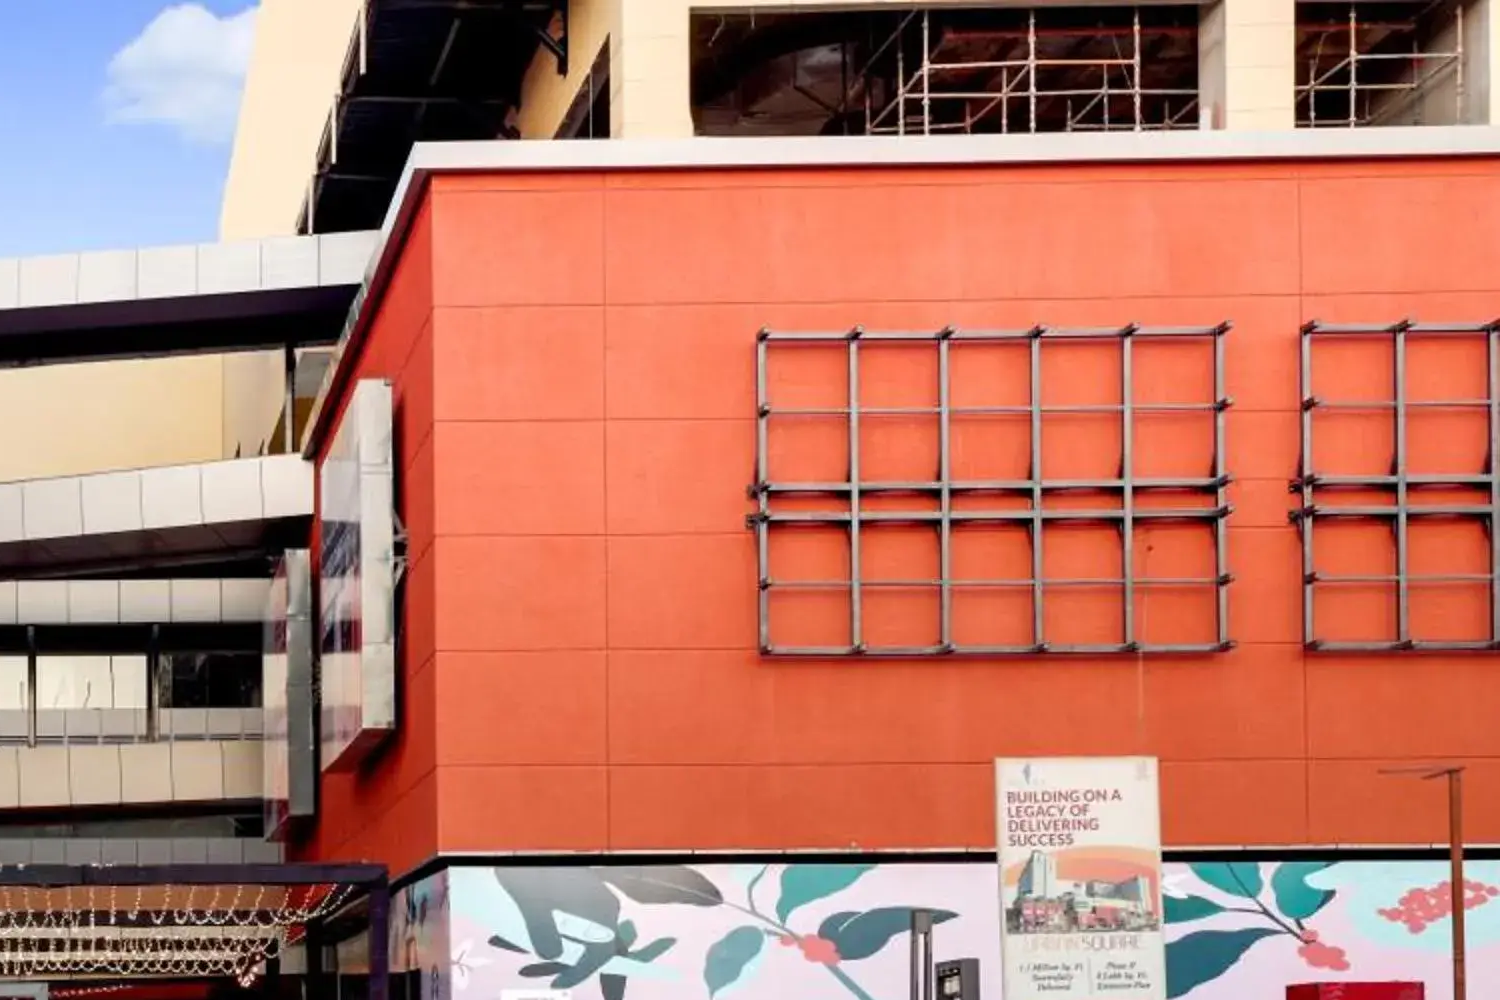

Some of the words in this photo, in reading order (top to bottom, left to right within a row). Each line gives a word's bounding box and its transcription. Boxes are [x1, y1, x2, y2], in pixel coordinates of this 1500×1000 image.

[1007, 789, 1080, 803] BUILDING
[1083, 788, 1108, 802] ON
[1111, 788, 1122, 801] A
[1007, 805, 1066, 818] LEGACY
[1070, 804, 1091, 817] OF
[1008, 818, 1100, 832] DELIVERING
[1008, 833, 1075, 847] SUCCESS
